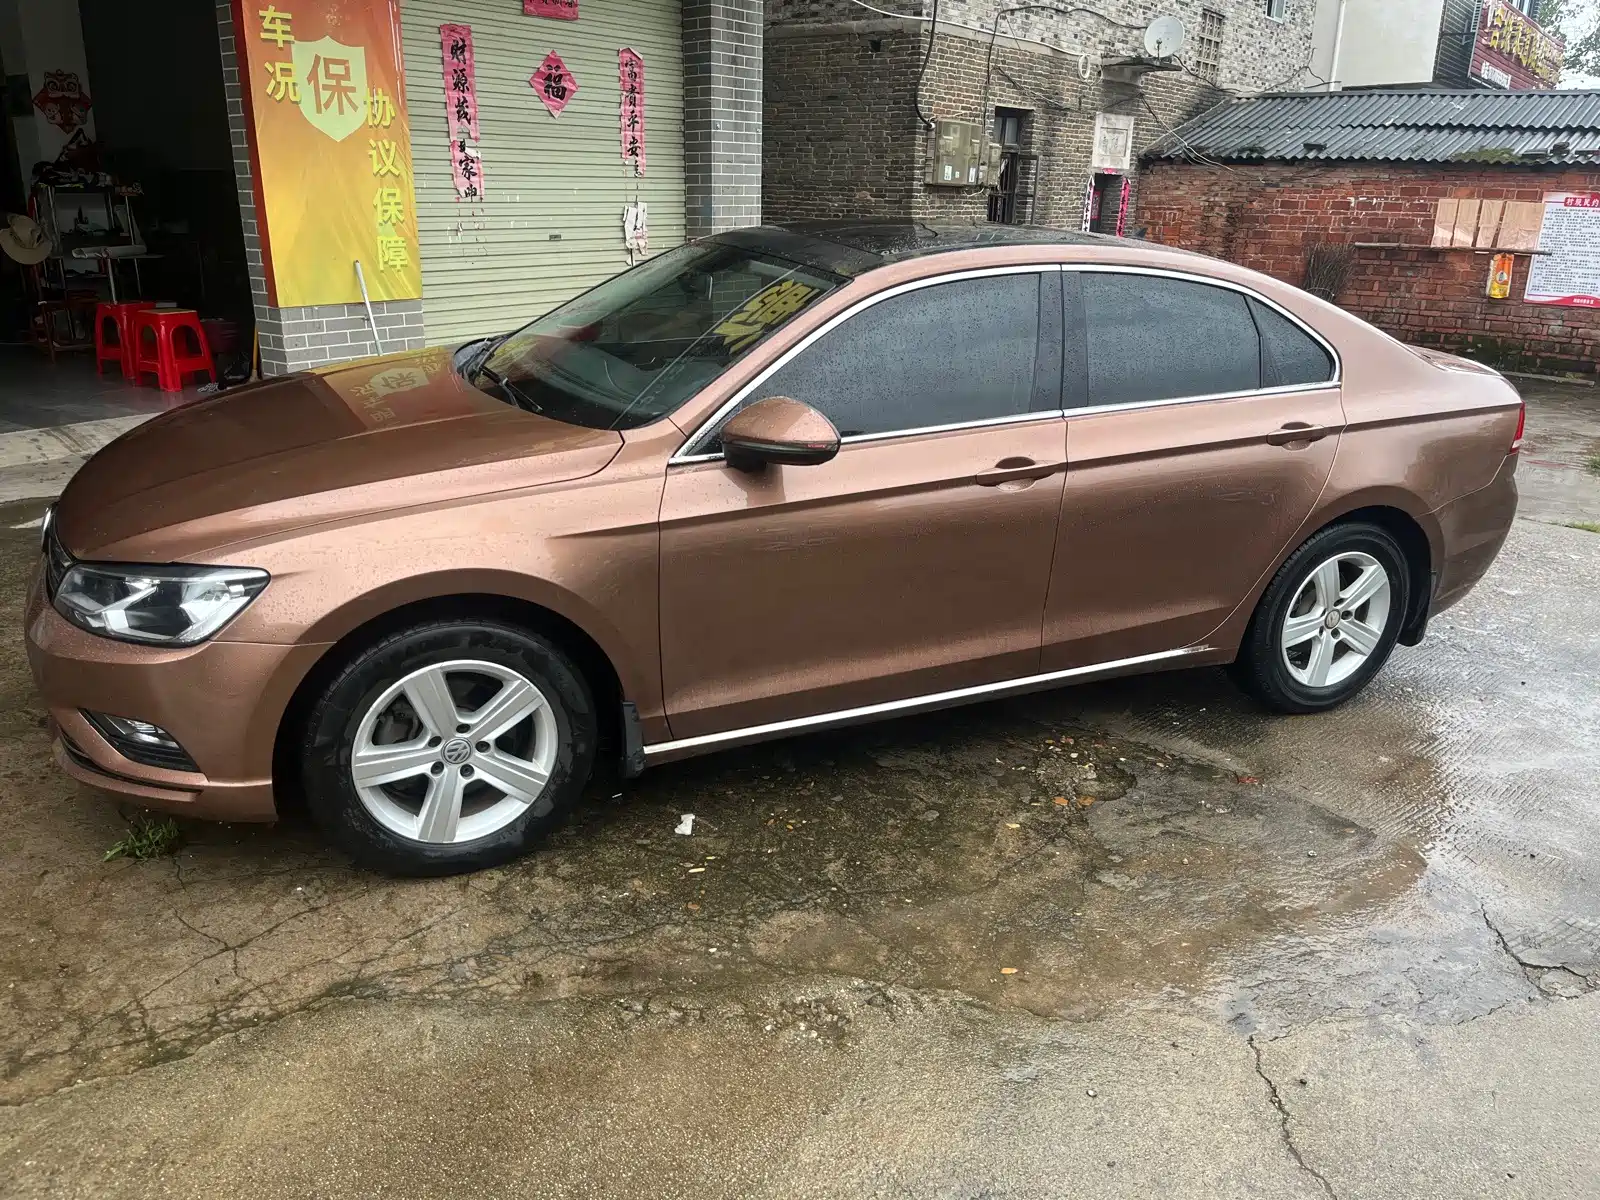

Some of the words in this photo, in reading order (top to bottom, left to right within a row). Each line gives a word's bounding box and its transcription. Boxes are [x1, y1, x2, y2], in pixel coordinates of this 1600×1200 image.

[258, 5, 302, 103] 车况
[306, 53, 359, 116] 保
[543, 64, 567, 100] 福
[364, 87, 409, 273] 协议保障
